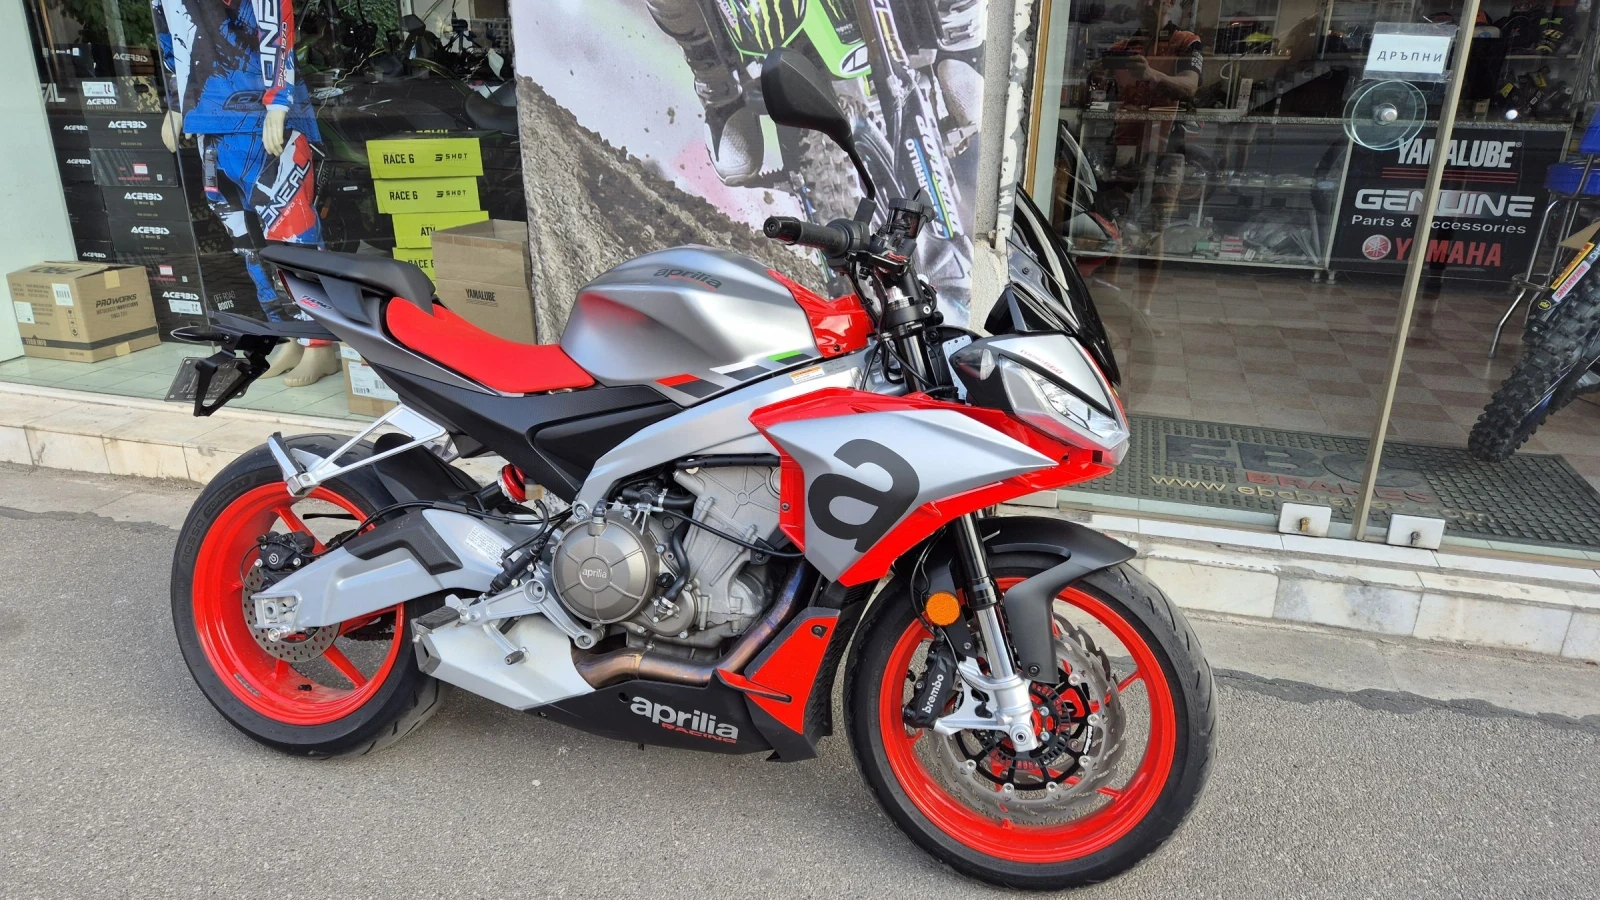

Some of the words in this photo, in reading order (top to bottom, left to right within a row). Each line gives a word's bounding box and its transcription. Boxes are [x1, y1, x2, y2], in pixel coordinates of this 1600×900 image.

[113, 52, 148, 63] ACERBIS
[1376, 50, 1442, 62] ДРЪПНИ
[108, 120, 147, 129] ACERBIS
[383, 153, 406, 165] RACE
[408, 153, 415, 164] 6
[445, 152, 468, 160] SHOT
[124, 191, 163, 201] ACERBIS
[389, 190, 411, 201] RACE
[412, 190, 418, 200] 6
[131, 225, 170, 235] ACERBIS
[1351, 214, 1395, 227] Parts
[1400, 217, 1412, 228] &
[1431, 219, 1527, 235] ccessories
[1395, 237, 1502, 267] YMAHA
[653, 268, 723, 289] aprilia
[162, 290, 199, 301] ACERBIS
[465, 288, 496, 302] YAMALUBE
[1166, 434, 1422, 488] EBC
[582, 568, 607, 580] aprilia
[922, 673, 944, 714] brembo
[630, 696, 739, 740] aprilia
[661, 722, 737, 744] RACING
